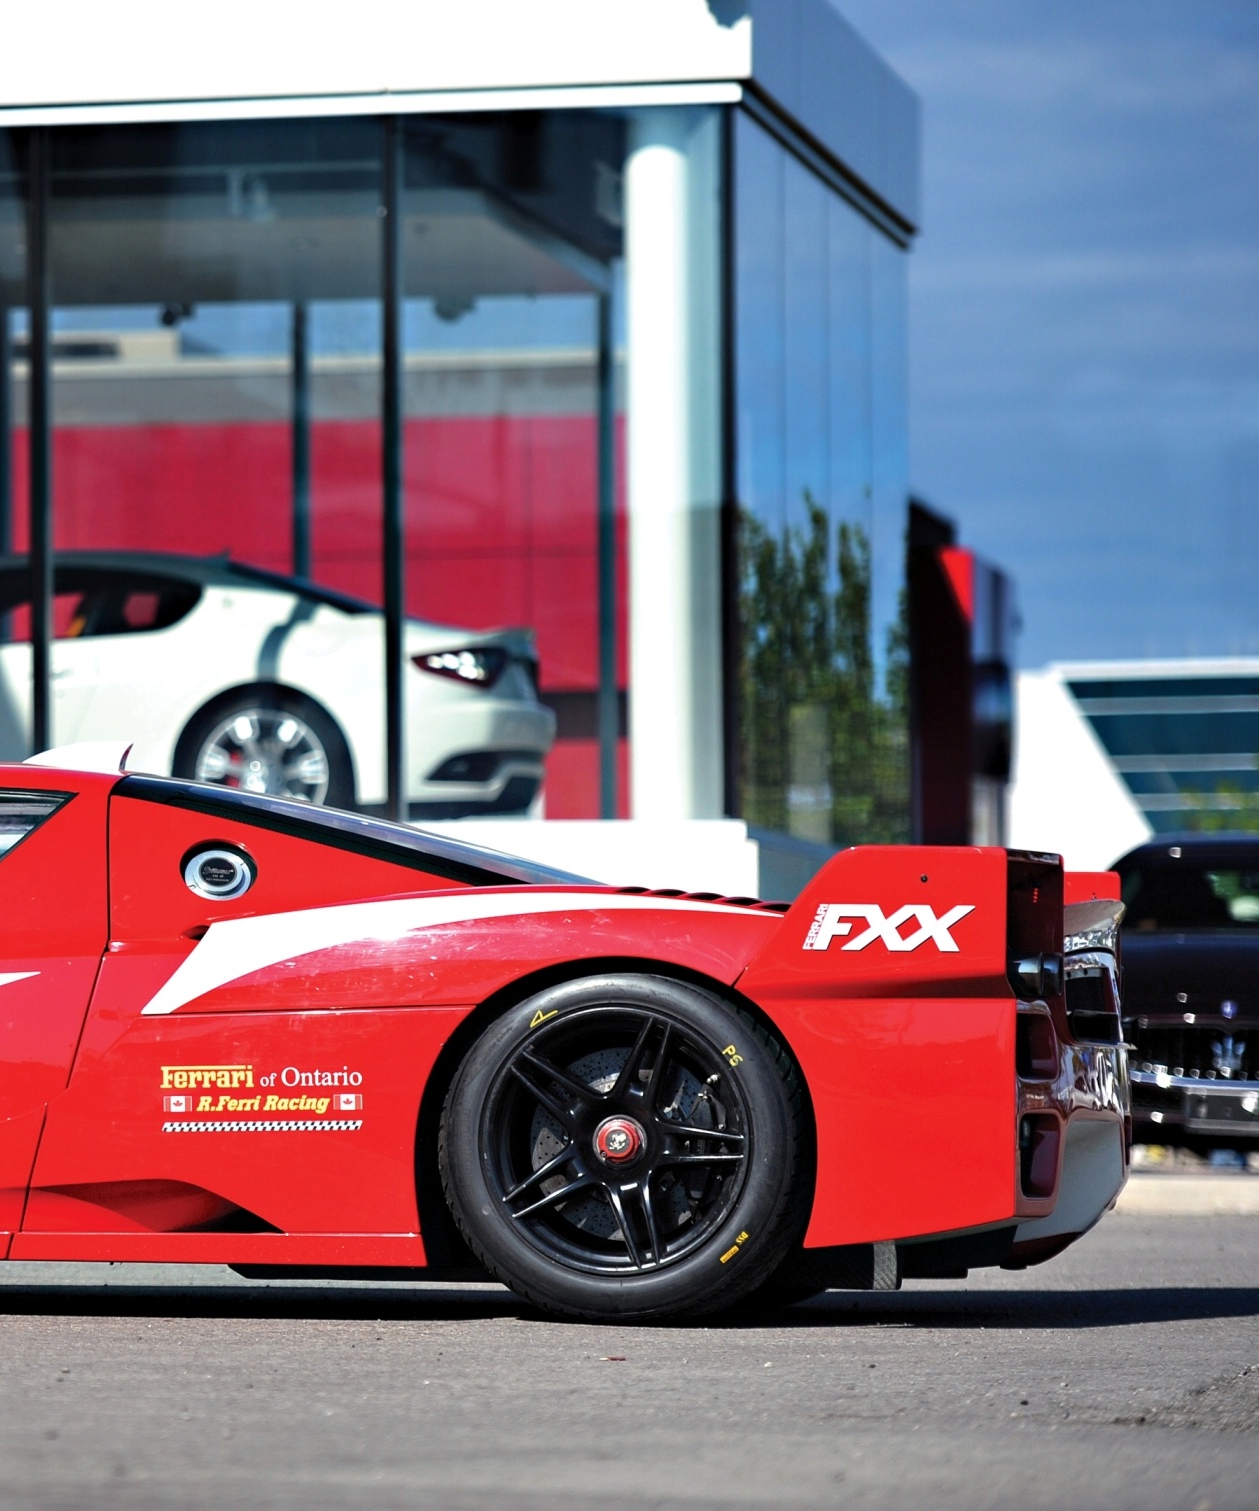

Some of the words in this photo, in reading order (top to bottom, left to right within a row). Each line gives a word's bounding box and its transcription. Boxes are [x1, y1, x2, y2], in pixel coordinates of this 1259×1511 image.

[802, 903, 829, 950] FERRARI
[812, 903, 976, 953] FXX
[160, 1065, 254, 1088] Ferrari
[260, 1072, 277, 1087] of
[281, 1066, 362, 1087] Ontario
[196, 1096, 261, 1111] R.Ferri
[263, 1095, 330, 1114] Racing
